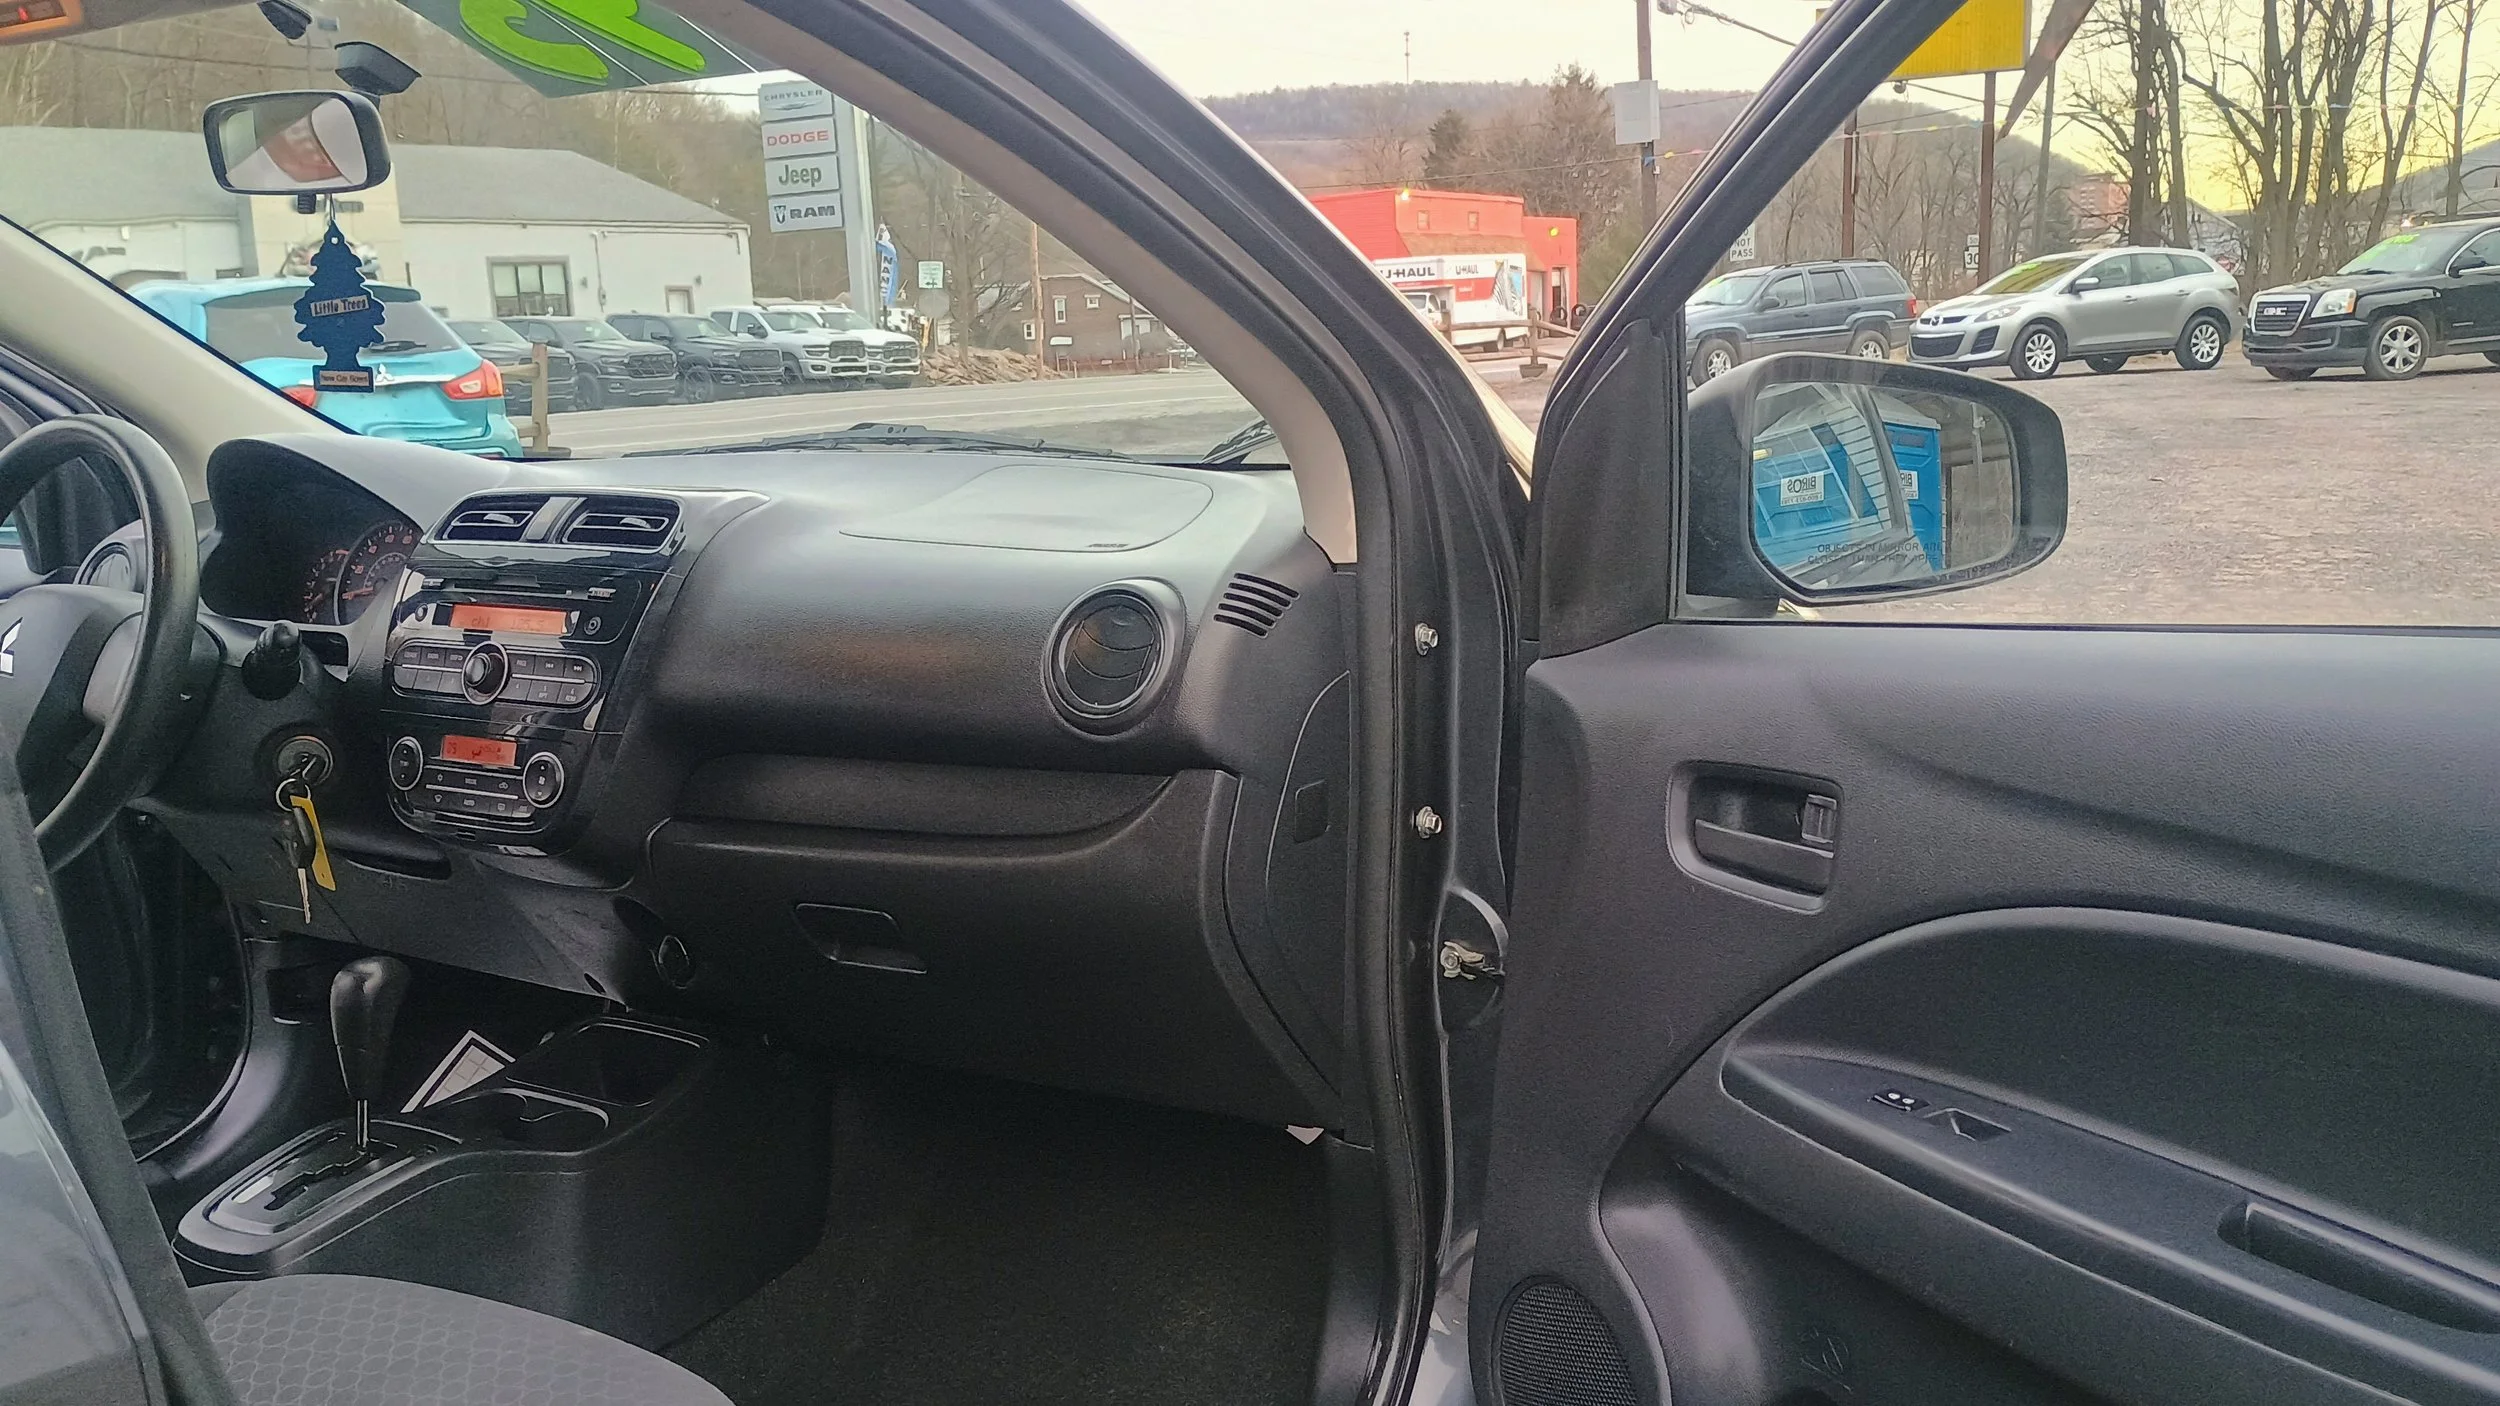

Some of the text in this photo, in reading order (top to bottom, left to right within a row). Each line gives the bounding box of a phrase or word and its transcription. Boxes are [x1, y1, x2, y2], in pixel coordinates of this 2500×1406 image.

[764, 89, 823, 102] CHRYSLER
[766, 130, 829, 147] DODGE
[778, 164, 822, 188] Jeep
[790, 205, 836, 219] RAM
[1735, 237, 1751, 248] NOT
[1731, 248, 1753, 259] PASS
[314, 299, 367, 315] Little Trees
[2263, 306, 2287, 316] GMC
